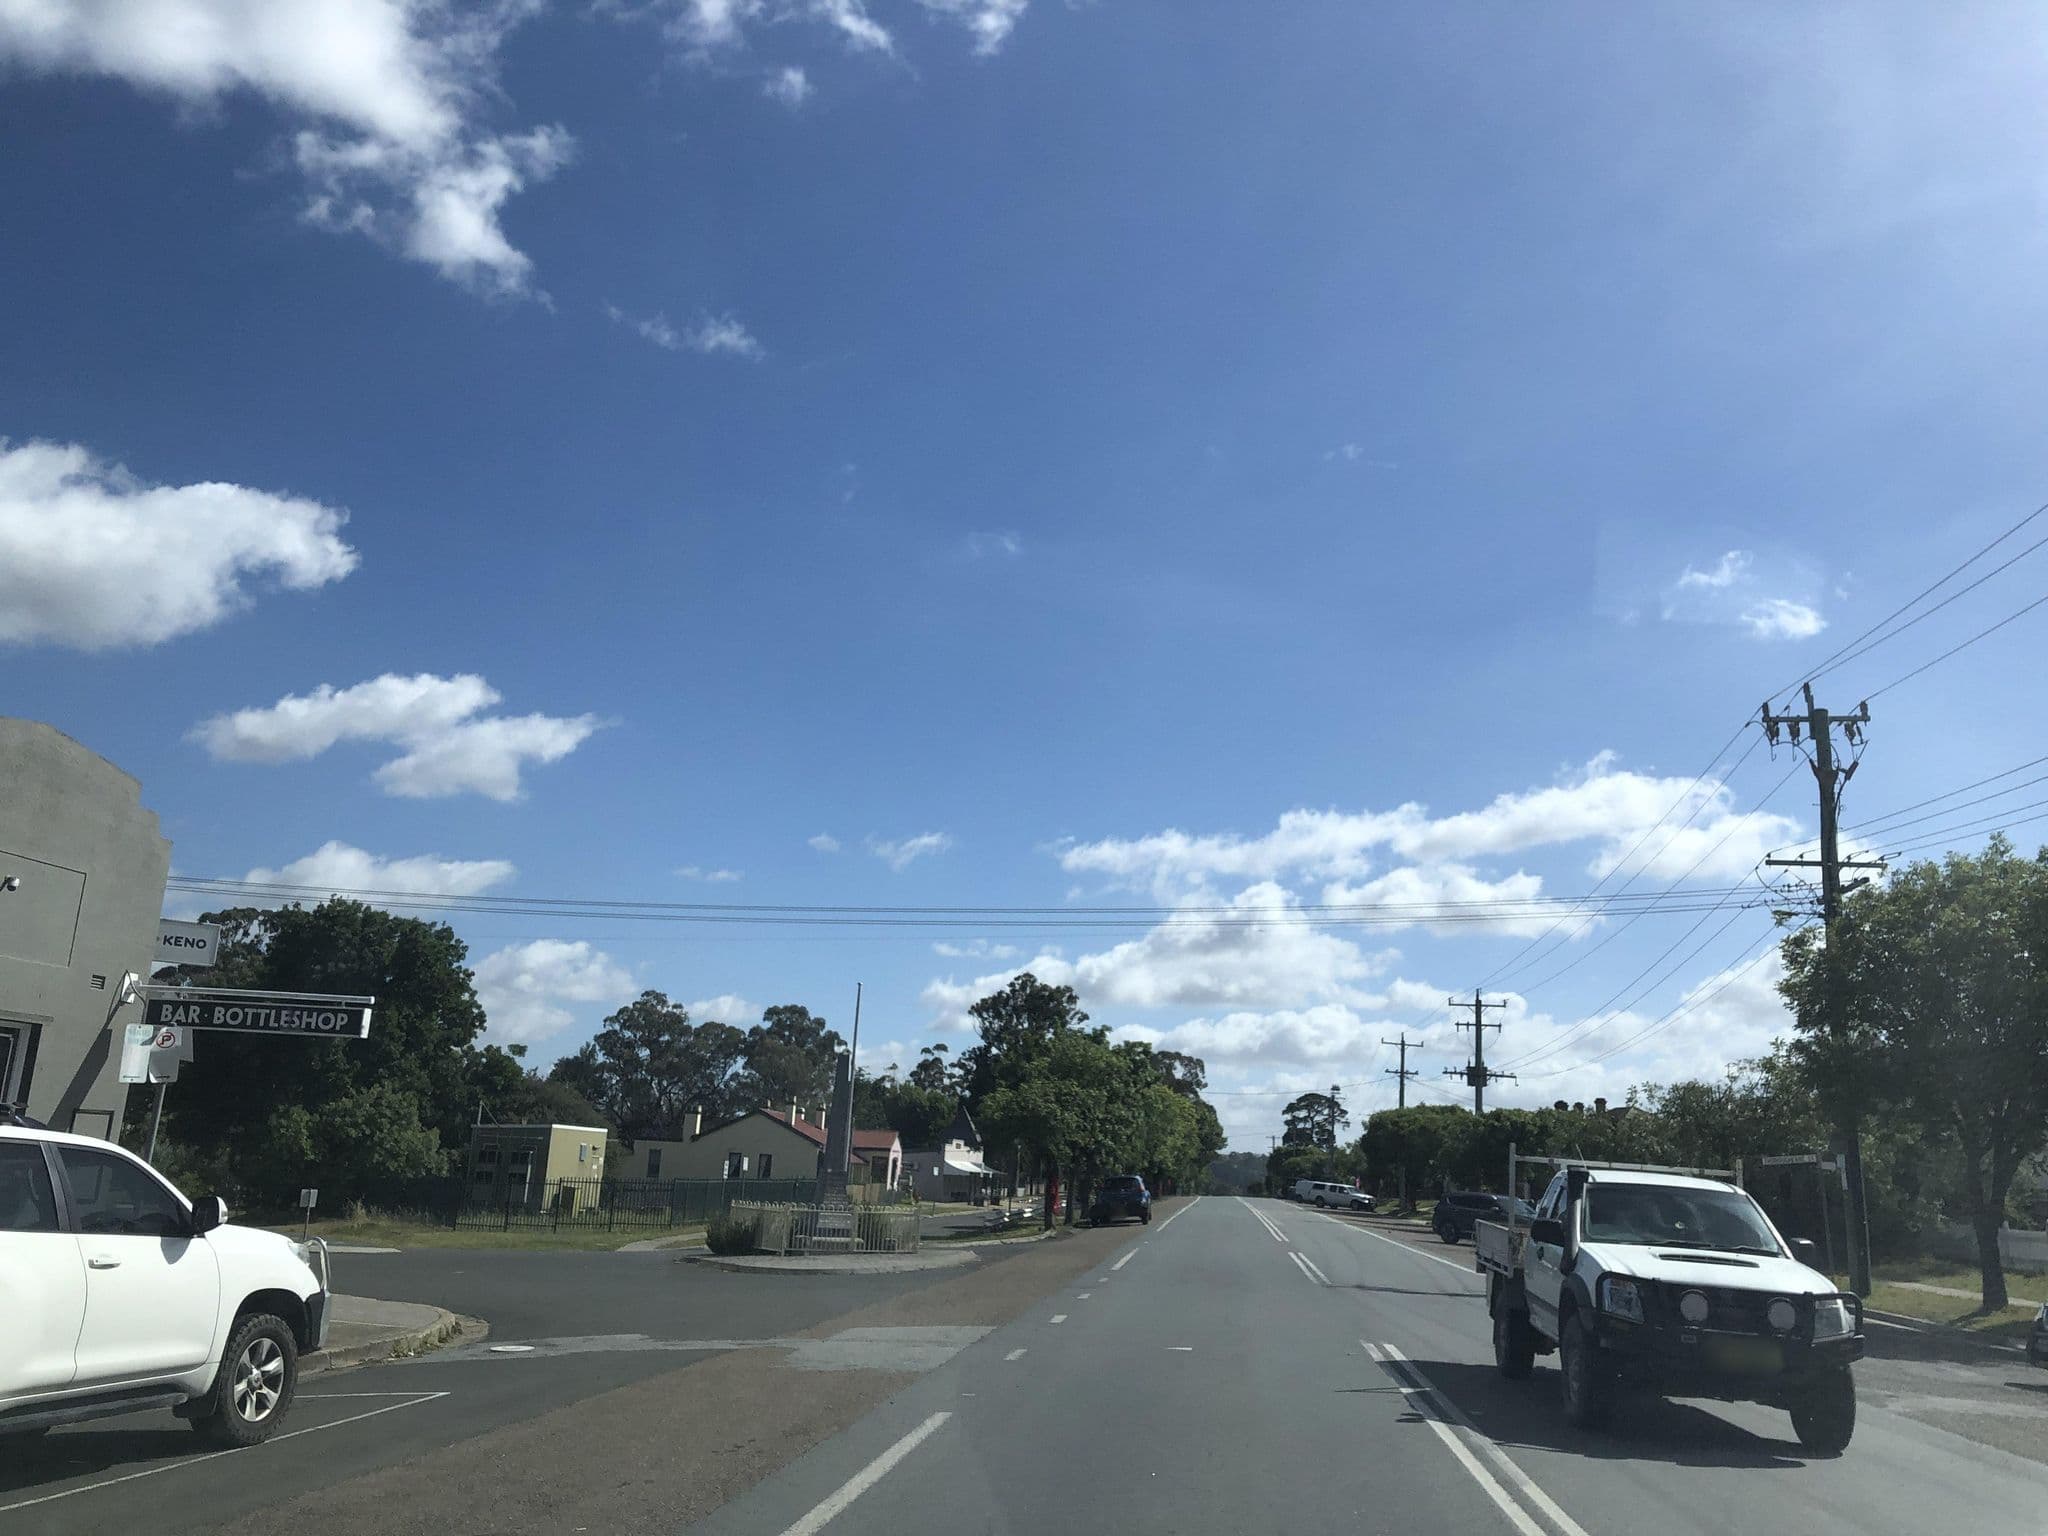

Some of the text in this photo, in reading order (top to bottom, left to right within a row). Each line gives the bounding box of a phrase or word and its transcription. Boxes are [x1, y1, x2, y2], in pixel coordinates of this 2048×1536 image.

[162, 934, 207, 949] KENO
[160, 1004, 349, 1031] BAR BOTTLESHOP
